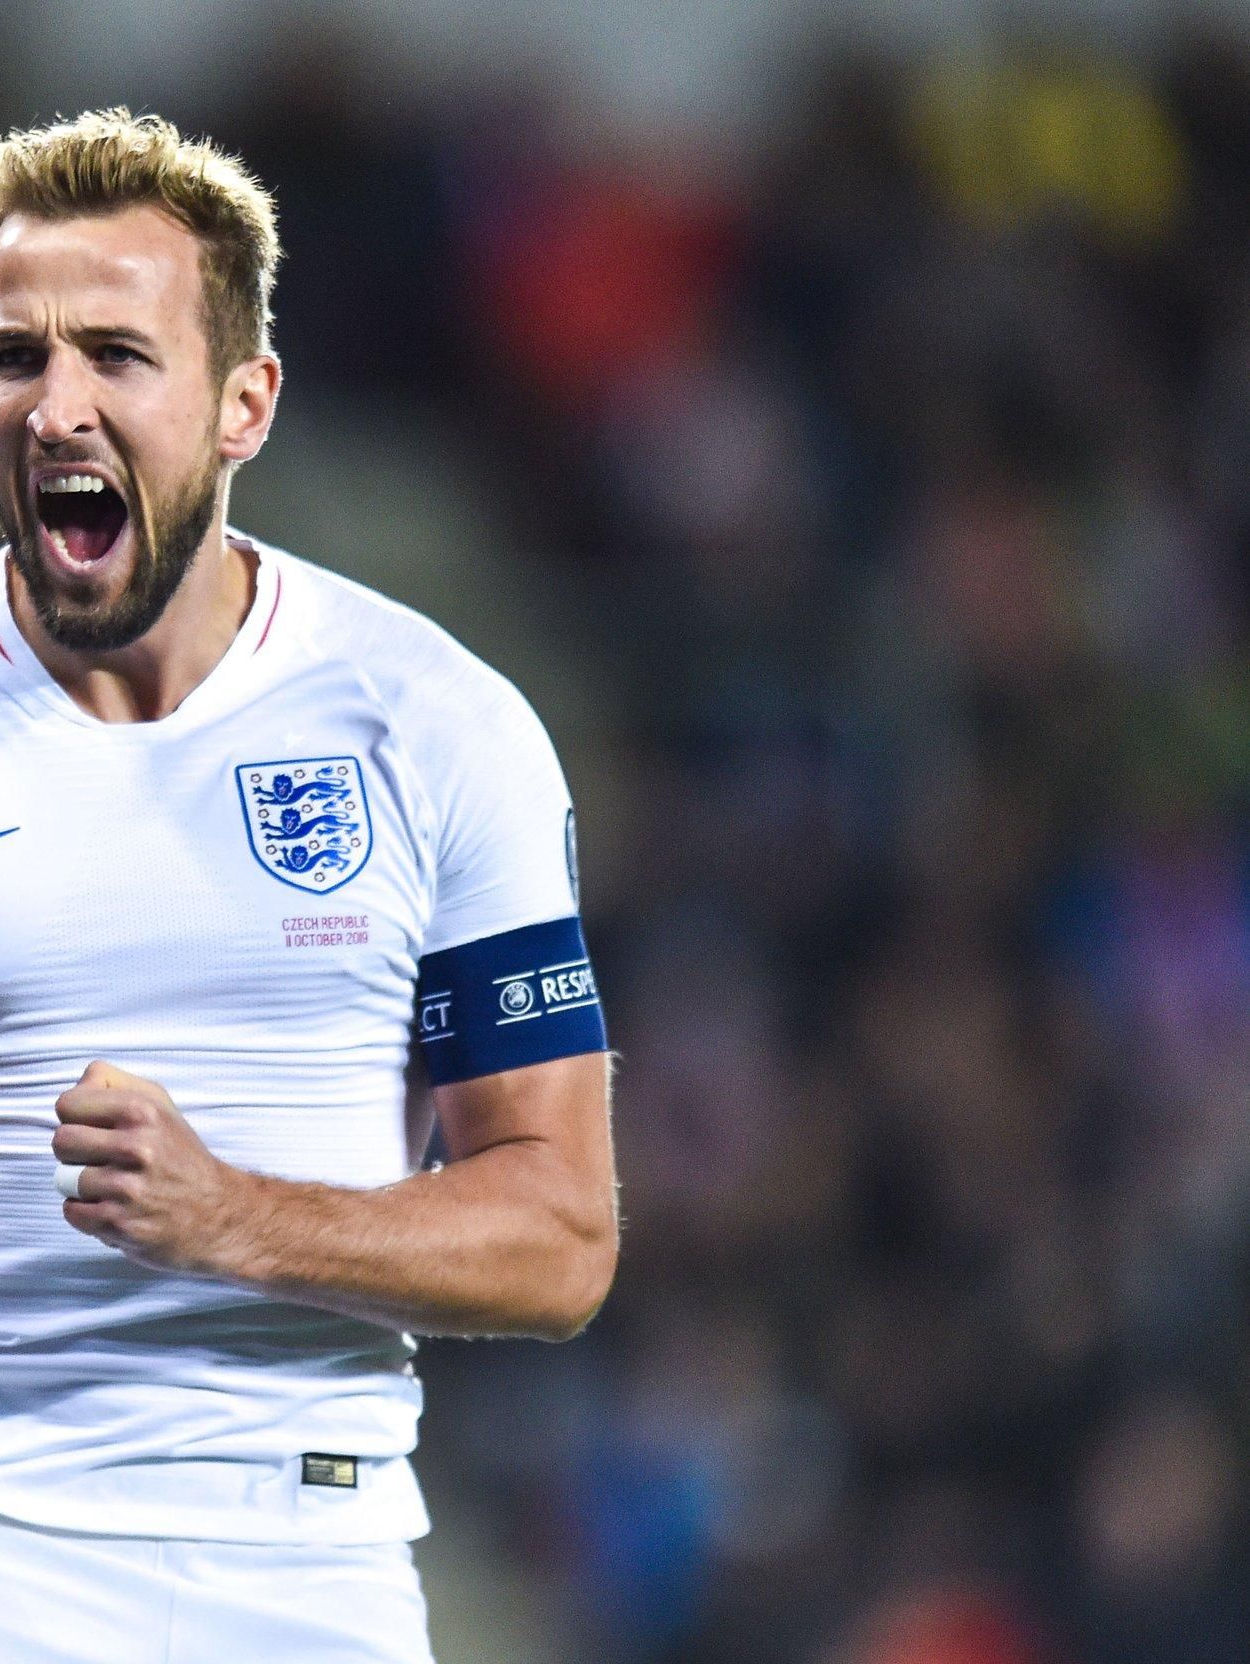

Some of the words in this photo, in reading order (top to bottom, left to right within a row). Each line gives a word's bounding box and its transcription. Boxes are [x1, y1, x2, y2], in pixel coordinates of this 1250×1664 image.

[282, 917, 318, 931] CZECH
[321, 915, 368, 929] REPUBLIC
[285, 934, 291, 947] 11
[294, 933, 342, 947] OCTOBER
[346, 931, 368, 945] 2019
[419, 1002, 450, 1032] CT
